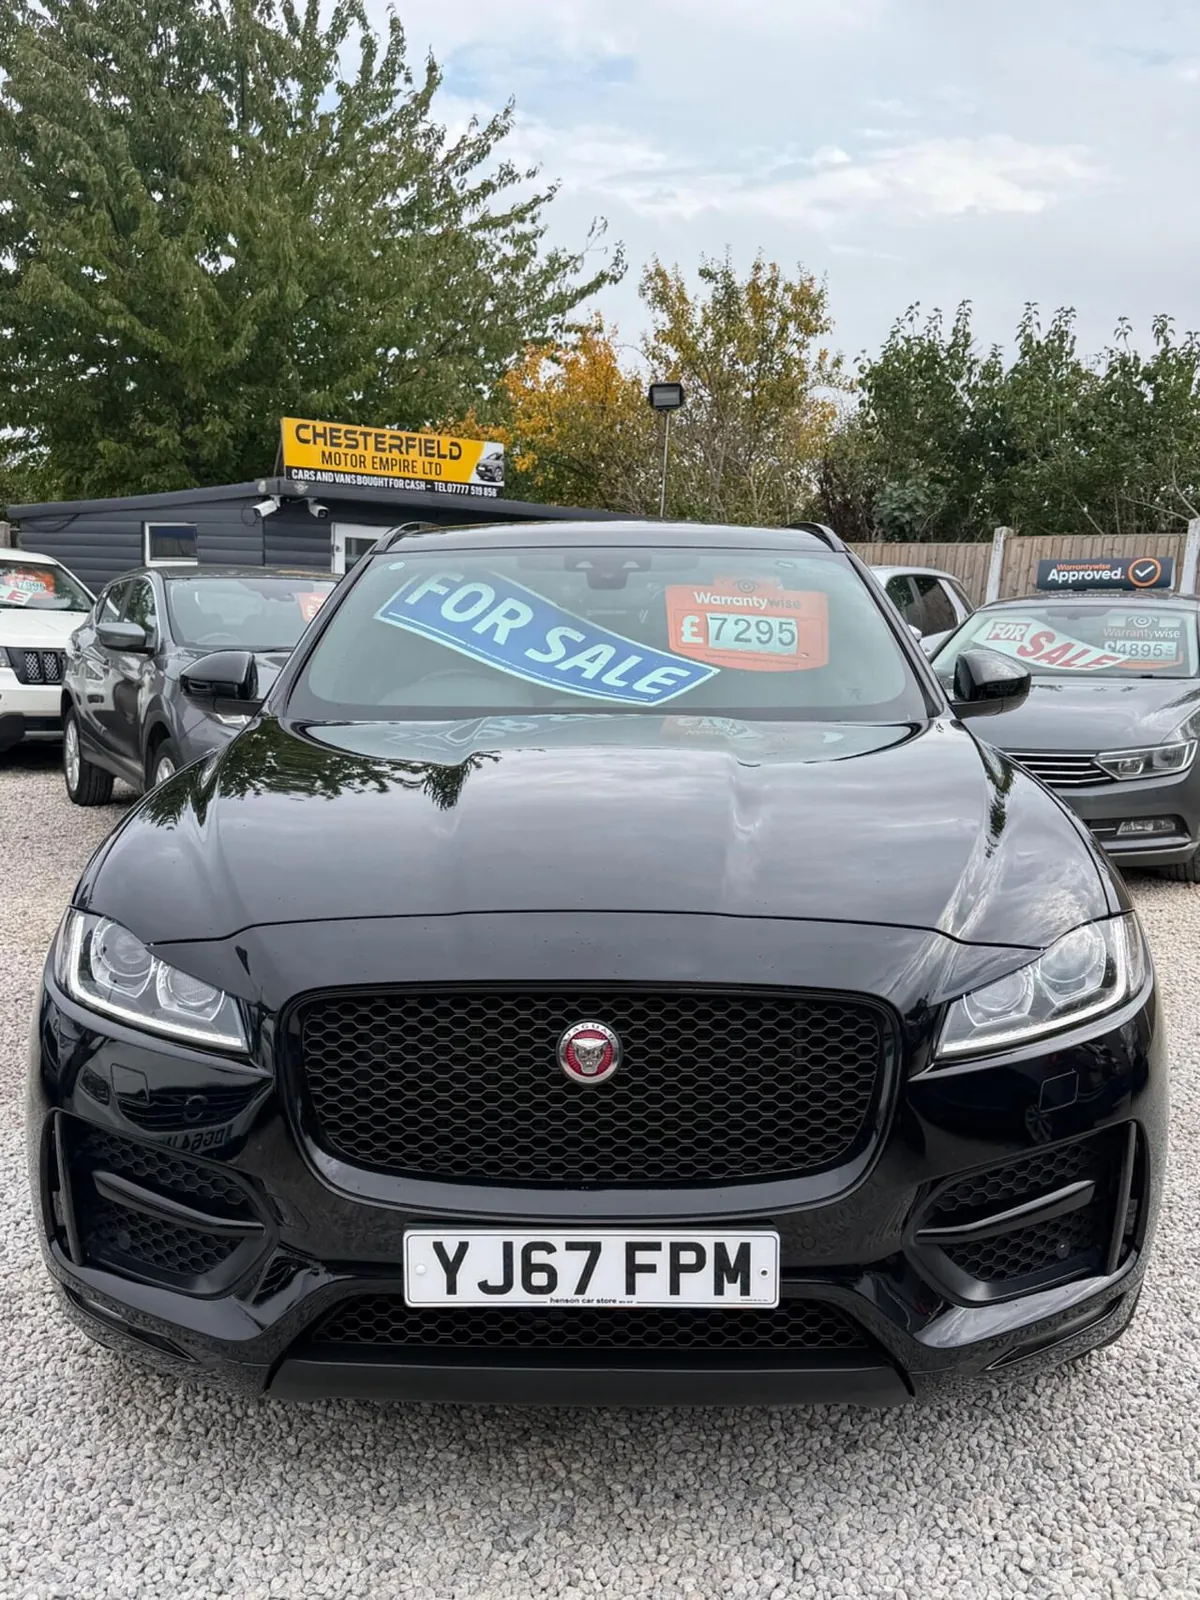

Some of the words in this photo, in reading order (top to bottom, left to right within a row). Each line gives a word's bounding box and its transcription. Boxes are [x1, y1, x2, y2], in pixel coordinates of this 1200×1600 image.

[295, 423, 463, 461] CHESTERFIELD
[321, 450, 367, 469] MOTOR
[371, 458, 418, 475] EMPIRE
[422, 461, 442, 476] LTD
[291, 469, 315, 481] CARS
[316, 471, 334, 483] AND
[334, 473, 356, 485] VANS
[357, 475, 388, 488] BOUGHT
[388, 477, 404, 489] FOR
[404, 479, 426, 491] CASH
[1047, 567, 1125, 583] Approved.
[1056, 563, 1111, 572] Warrantywise
[693, 591, 802, 610] Warrantywise
[404, 571, 534, 646] FOR
[523, 626, 691, 695] SALE
[1103, 626, 1181, 640] Warrantywise
[987, 622, 1028, 641] FOR
[1016, 630, 1121, 669] SALE
[432, 1240, 602, 1296] YJ67
[625, 1241, 751, 1296] FPM
